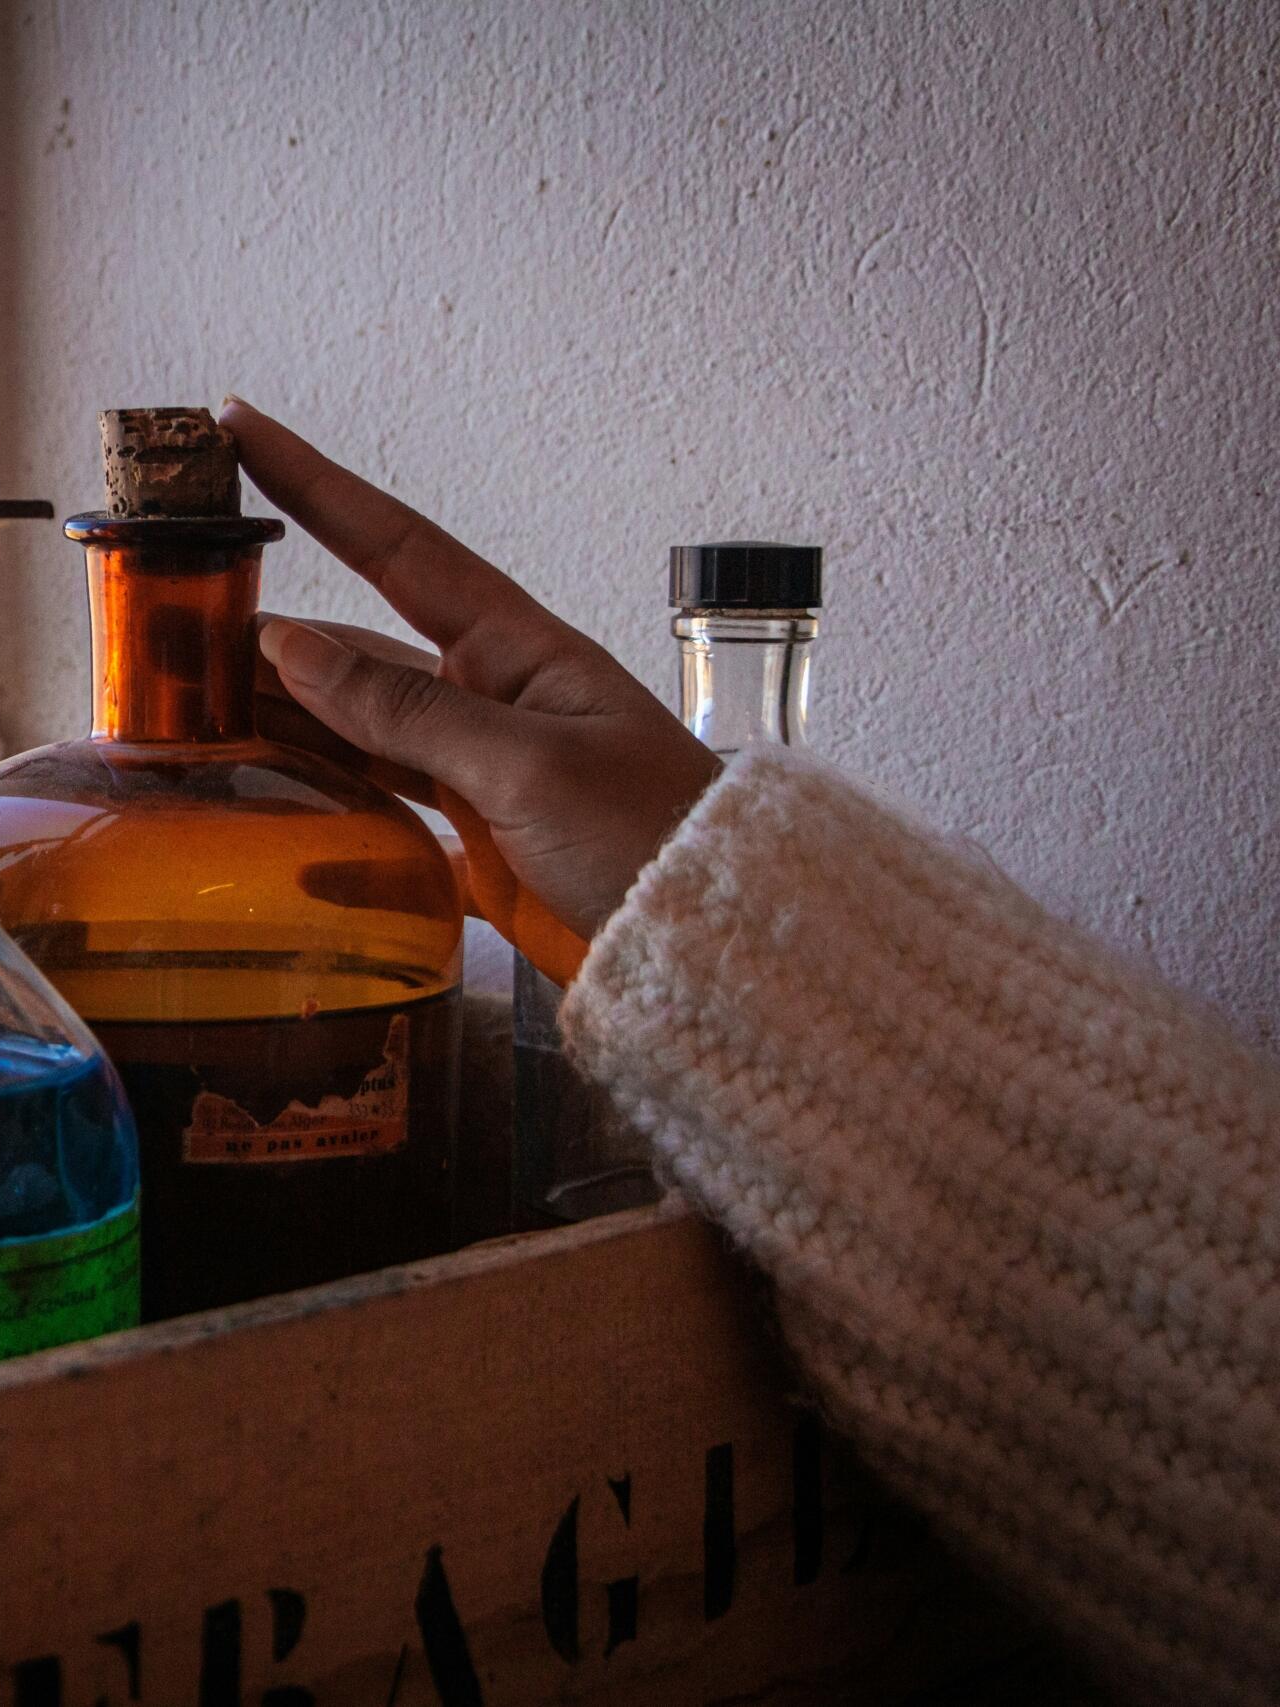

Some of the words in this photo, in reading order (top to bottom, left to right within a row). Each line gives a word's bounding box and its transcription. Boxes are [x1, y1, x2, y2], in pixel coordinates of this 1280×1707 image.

[225, 1140, 252, 1153] ne
[267, 1138, 302, 1154] pas
[316, 1129, 380, 1148] avaler
